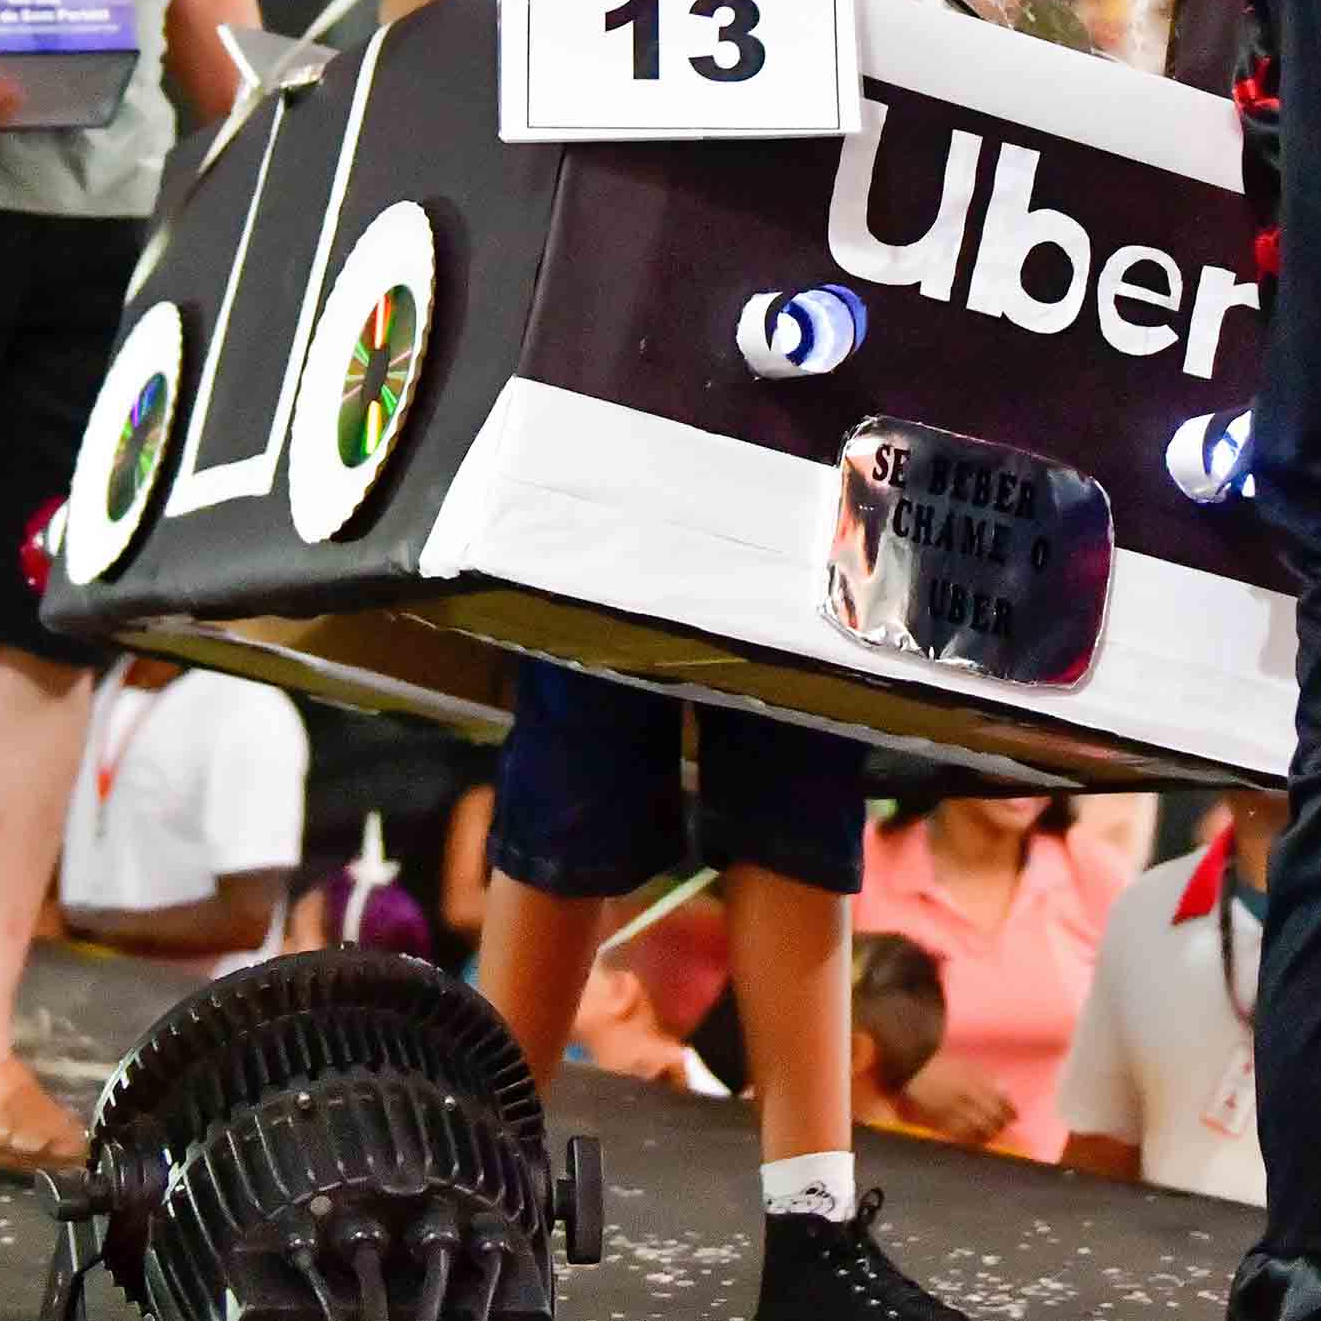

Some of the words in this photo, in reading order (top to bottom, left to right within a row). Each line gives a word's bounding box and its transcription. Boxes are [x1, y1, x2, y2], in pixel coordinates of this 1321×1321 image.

[828, 94, 1262, 380] Uber
[872, 443, 912, 488] SE
[892, 498, 1012, 563] CHAME
[1031, 536, 1048, 569] O
[930, 579, 1013, 637] UBER
